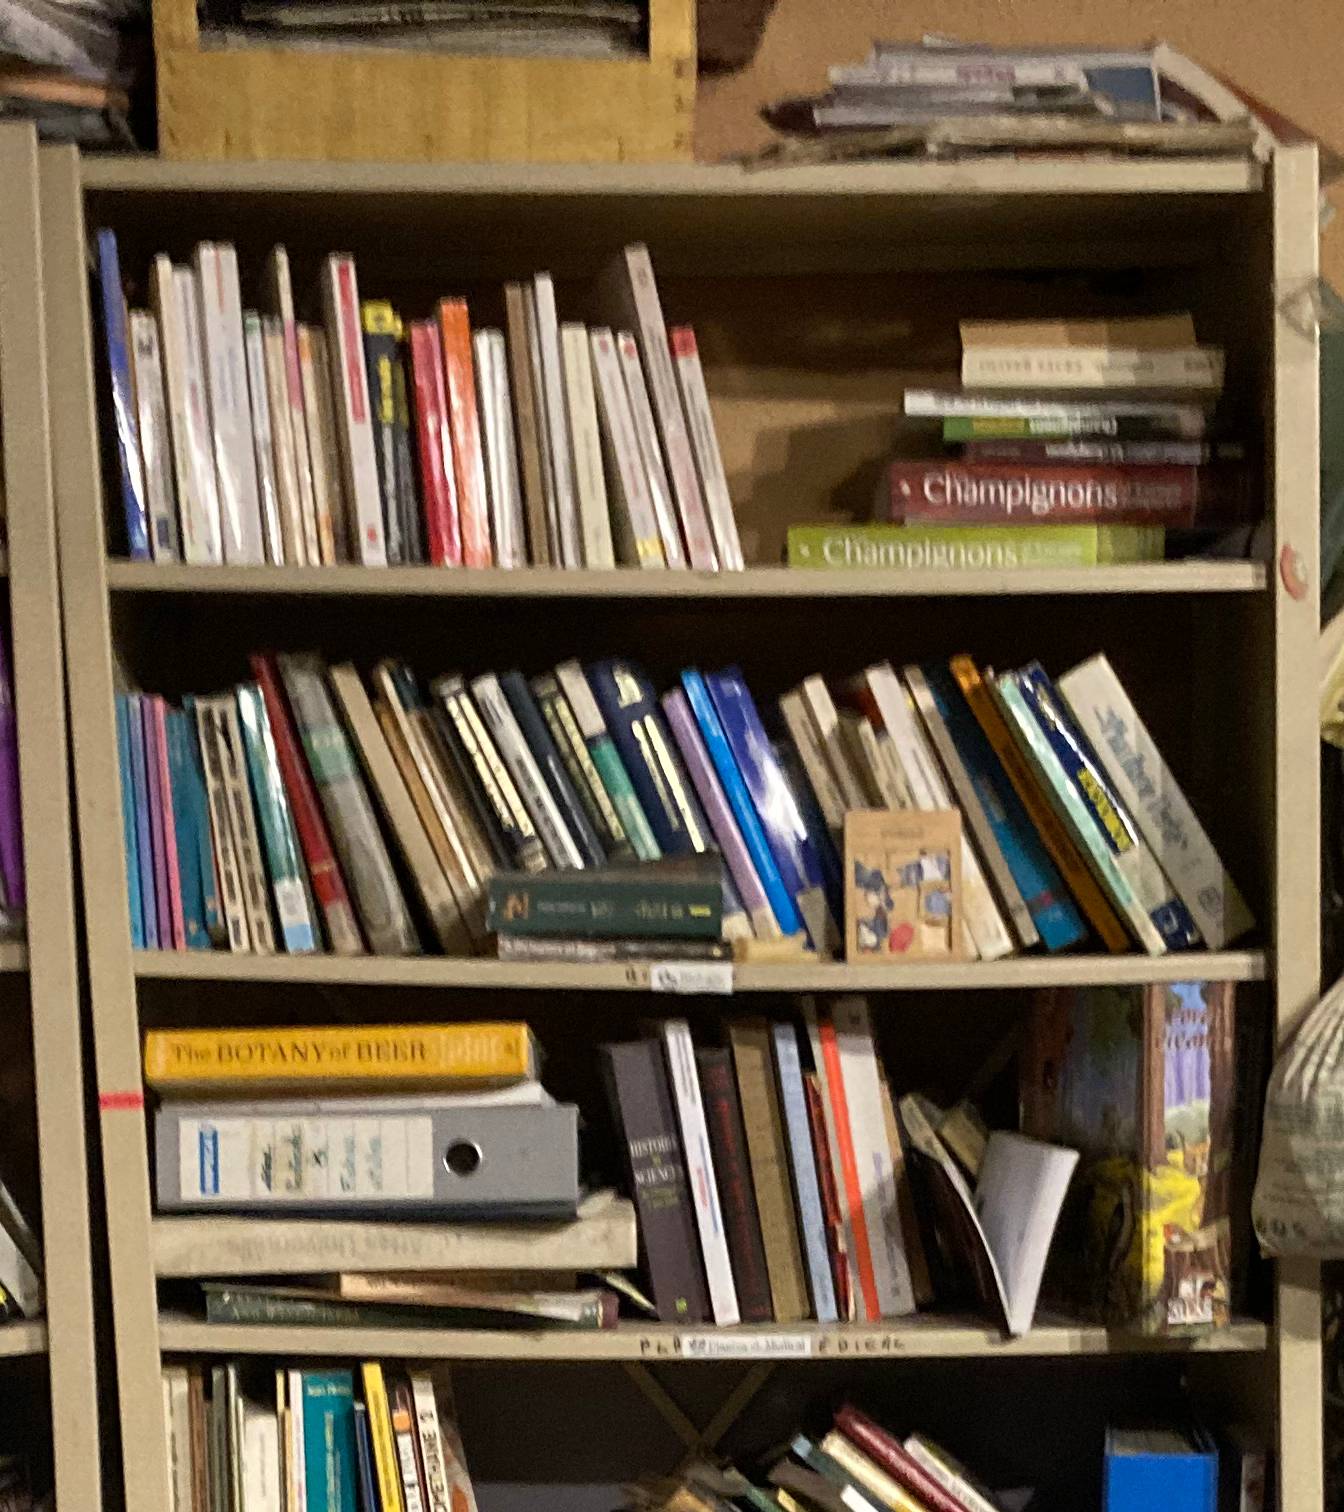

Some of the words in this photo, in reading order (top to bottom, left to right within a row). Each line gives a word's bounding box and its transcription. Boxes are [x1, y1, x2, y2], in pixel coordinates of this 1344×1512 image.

[922, 473, 1118, 516] Champignons
[822, 536, 1018, 567] Champignons
[174, 1039, 211, 1063] The
[216, 1040, 323, 1064] BOTANY
[329, 1042, 349, 1061] of
[355, 1039, 426, 1063] BEER
